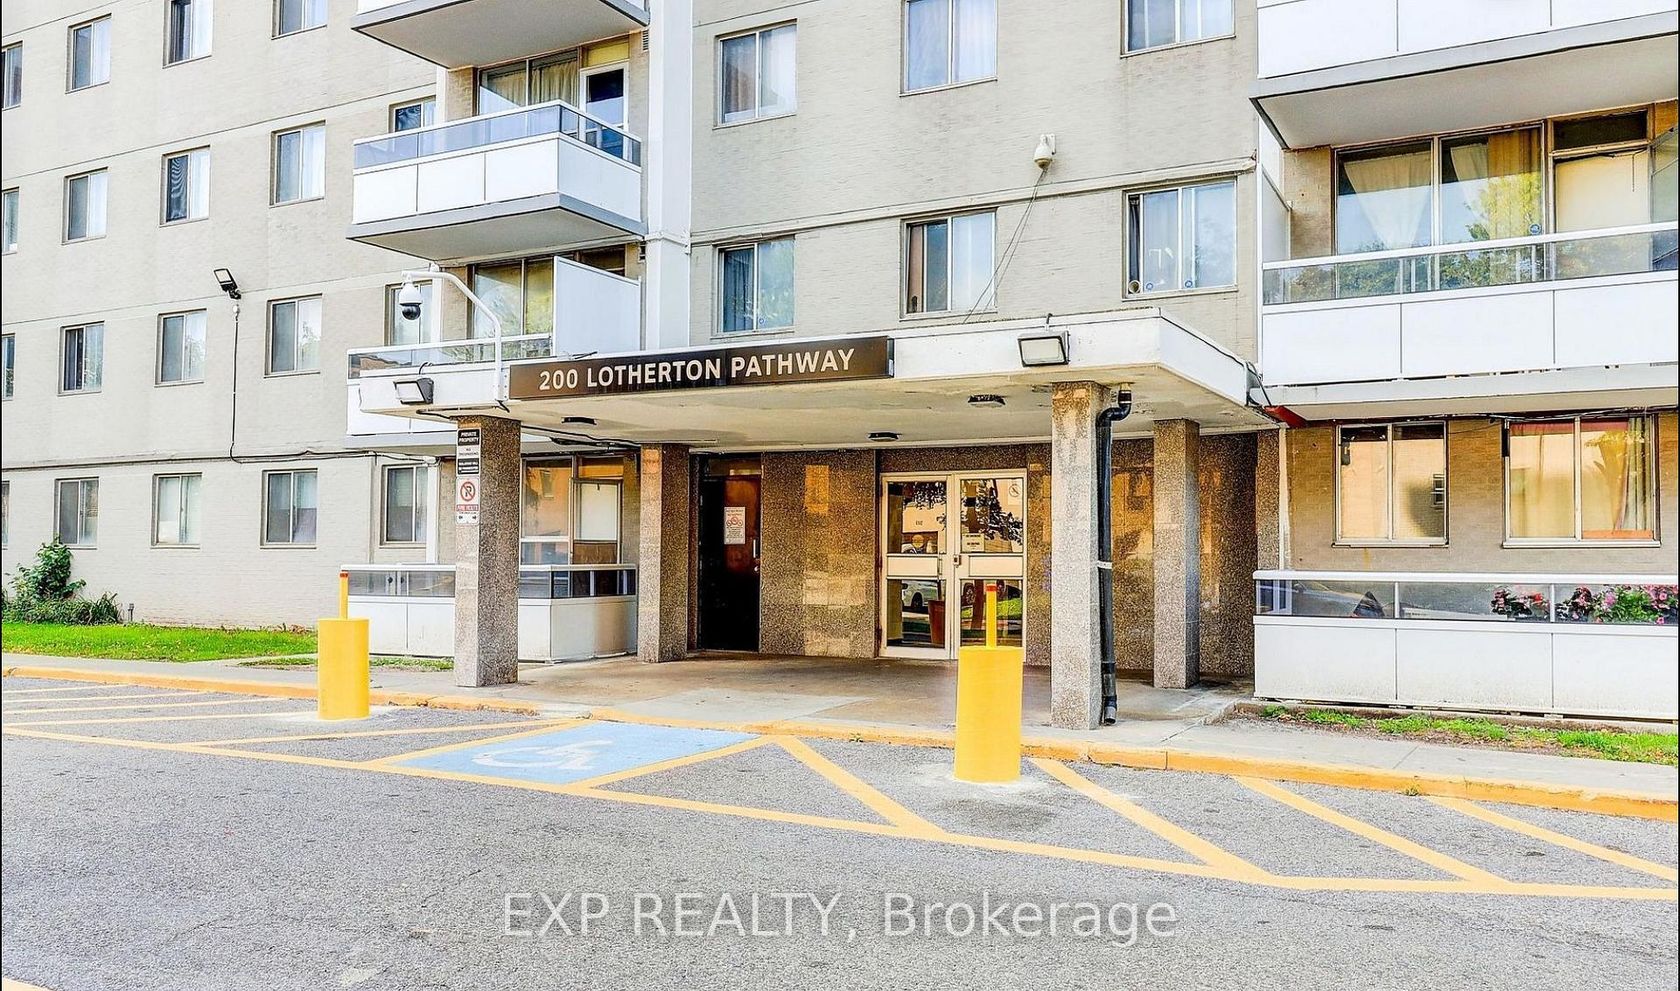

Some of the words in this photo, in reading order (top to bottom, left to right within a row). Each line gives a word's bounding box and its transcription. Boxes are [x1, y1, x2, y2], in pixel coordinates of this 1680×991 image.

[539, 368, 579, 391] 200
[587, 358, 721, 388] LOTHERTON
[730, 348, 855, 378] PATHWAY
